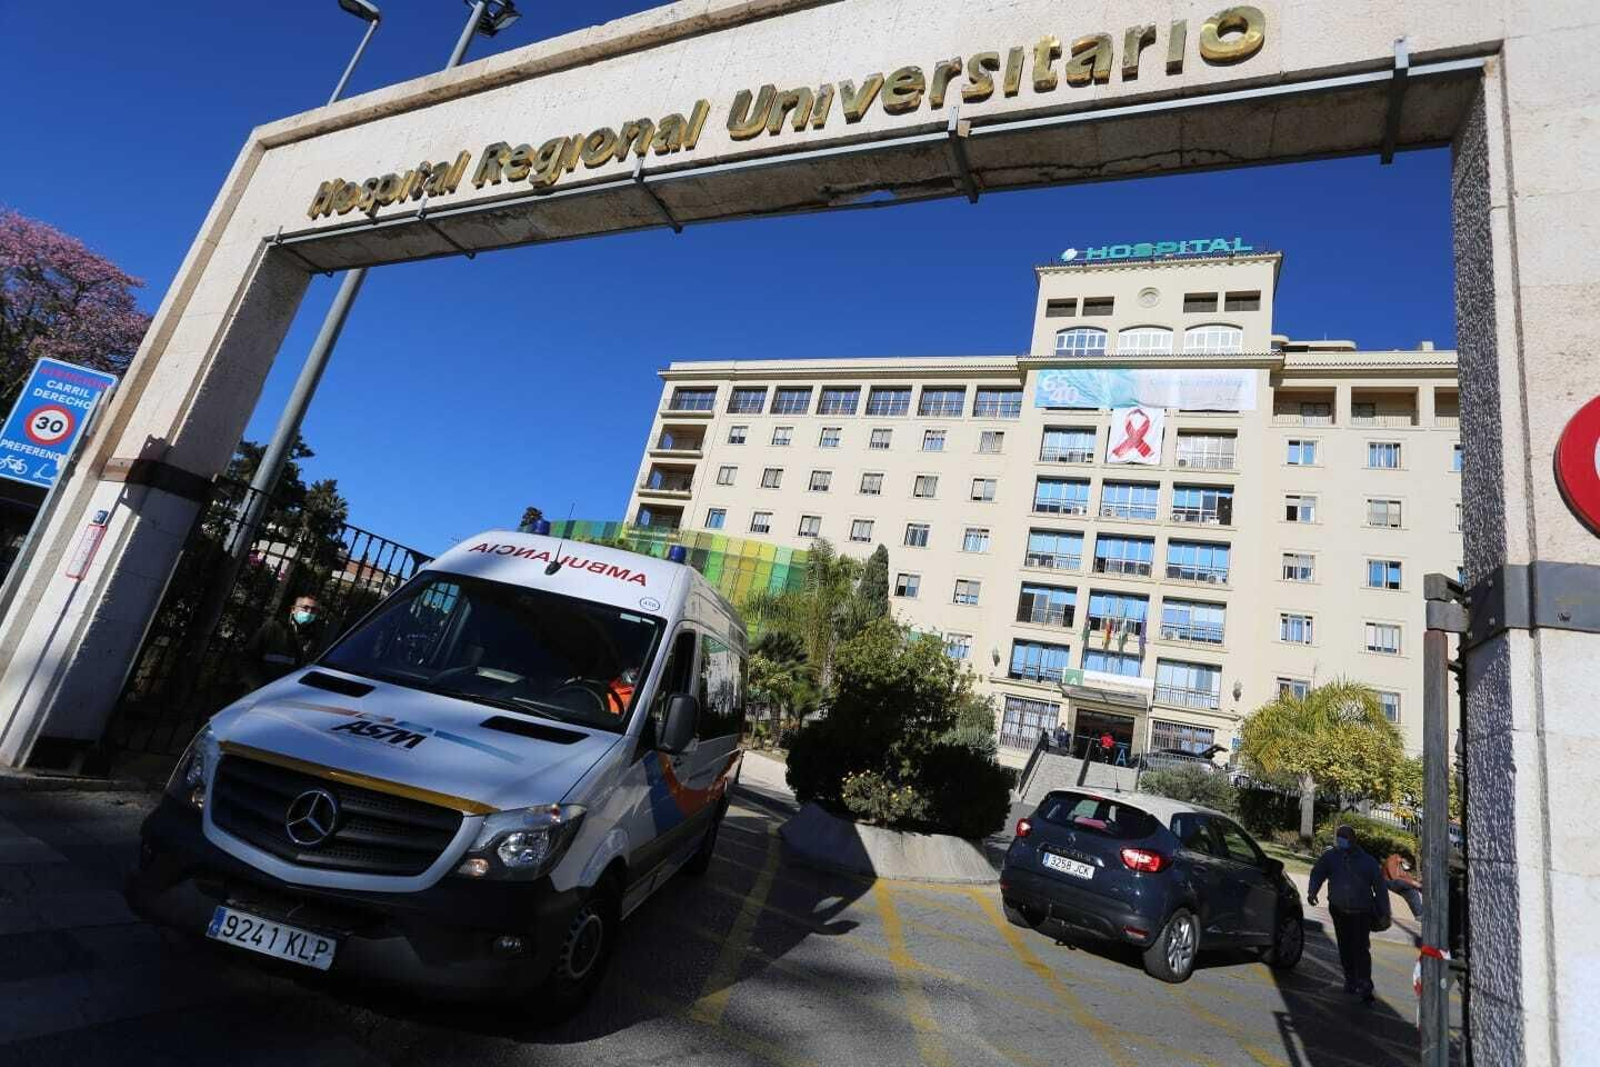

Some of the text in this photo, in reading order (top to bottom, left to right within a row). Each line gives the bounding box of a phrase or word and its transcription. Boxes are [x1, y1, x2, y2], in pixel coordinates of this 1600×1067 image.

[306, 5, 1266, 221] Hospital Regional Universitario
[1085, 237, 1253, 260] HOSPITAL
[33, 387, 92, 410] DERECHO
[45, 380, 90, 398] CARRIL
[35, 416, 64, 434] 30
[1050, 856, 1072, 870] 3258
[222, 915, 329, 962] 9241 KLP
